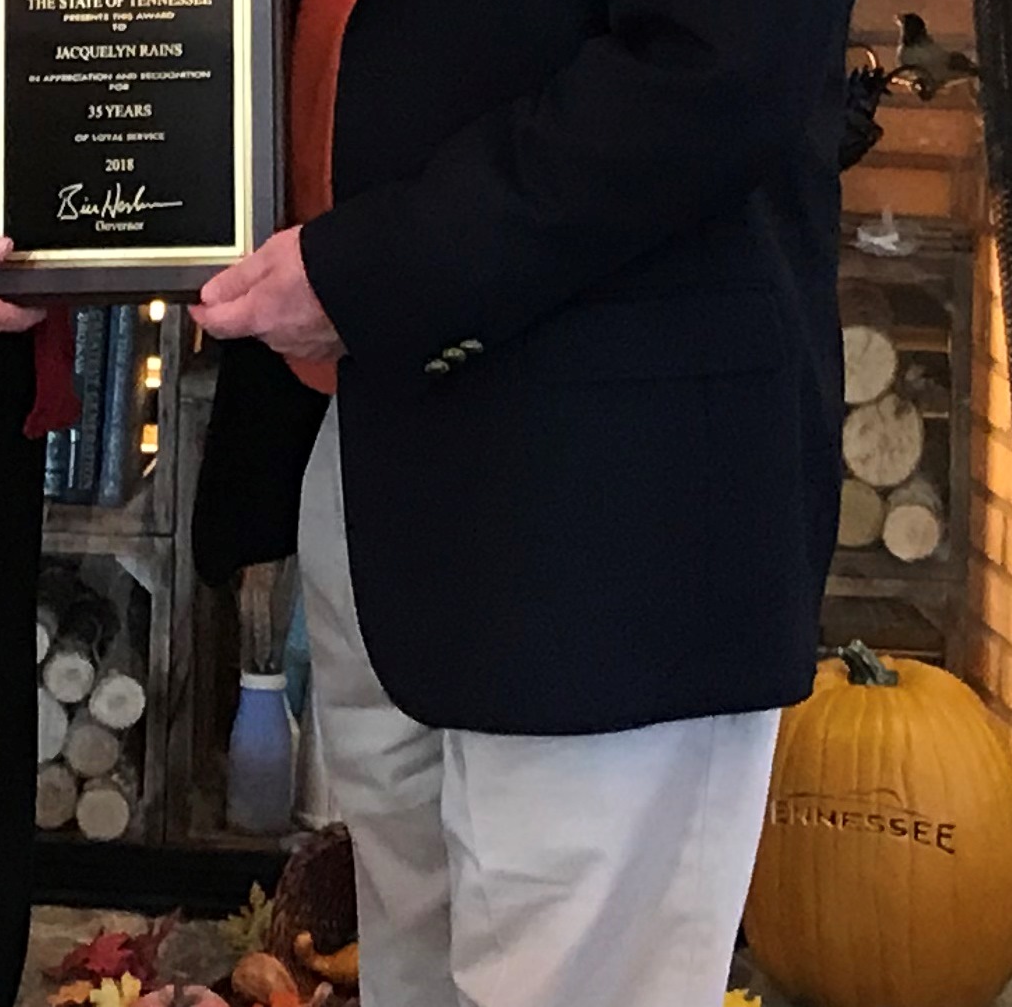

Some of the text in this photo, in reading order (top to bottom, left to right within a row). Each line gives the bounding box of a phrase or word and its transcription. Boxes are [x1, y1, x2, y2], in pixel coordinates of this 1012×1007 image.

[136, 11, 175, 20] AWARD
[55, 43, 183, 61] JACQUELYN RAINS
[87, 104, 152, 119] 35 YEARS
[105, 158, 134, 172] 2018
[95, 220, 144, 231] Governor
[771, 798, 956, 854] ENNESSEE
